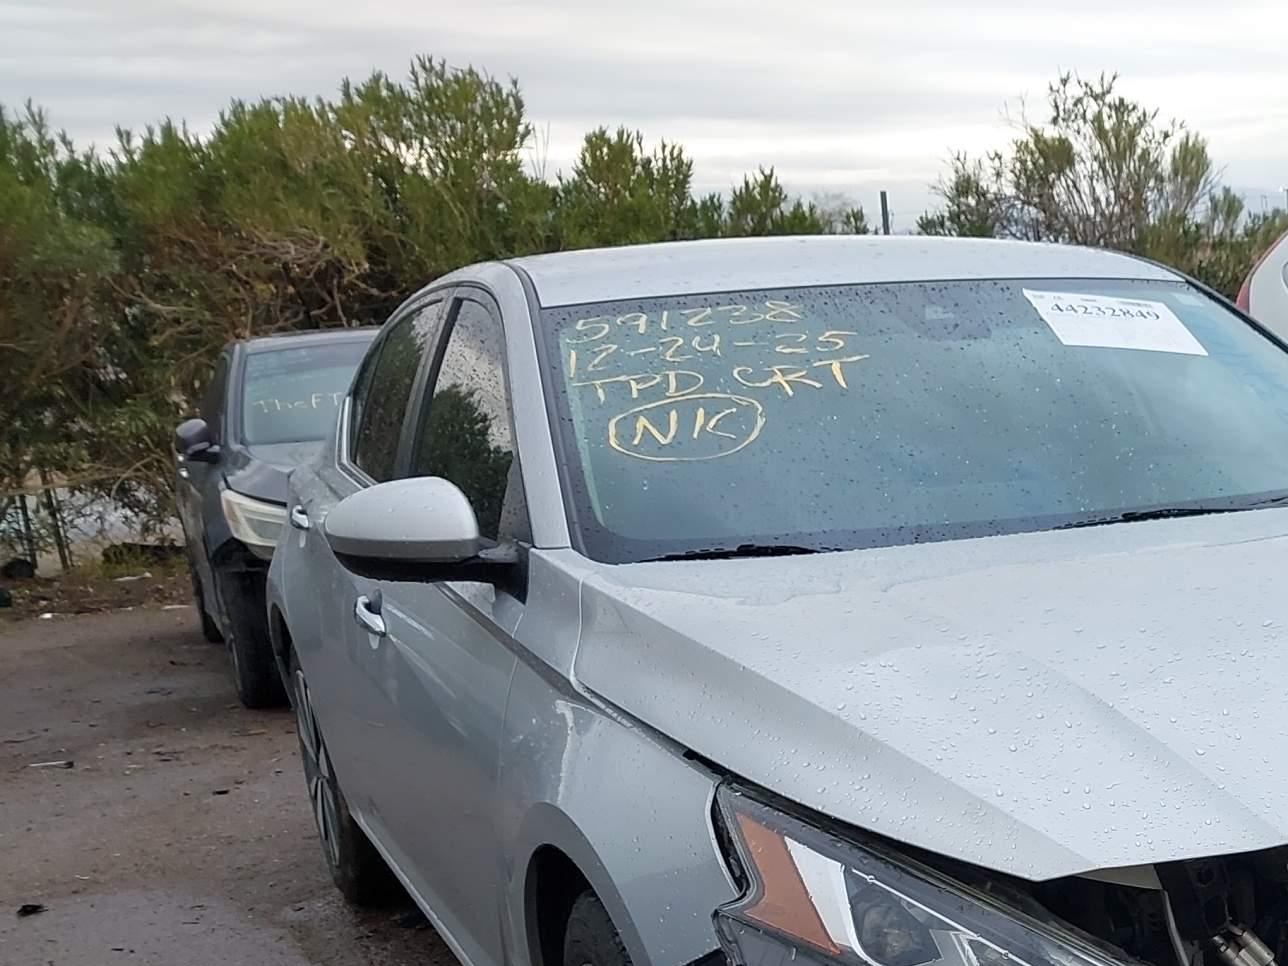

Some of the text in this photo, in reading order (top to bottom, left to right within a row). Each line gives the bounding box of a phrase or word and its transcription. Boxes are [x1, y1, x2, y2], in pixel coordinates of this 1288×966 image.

[566, 301, 803, 343] 591238
[571, 370, 704, 405] TPD
[632, 407, 737, 446] NK
